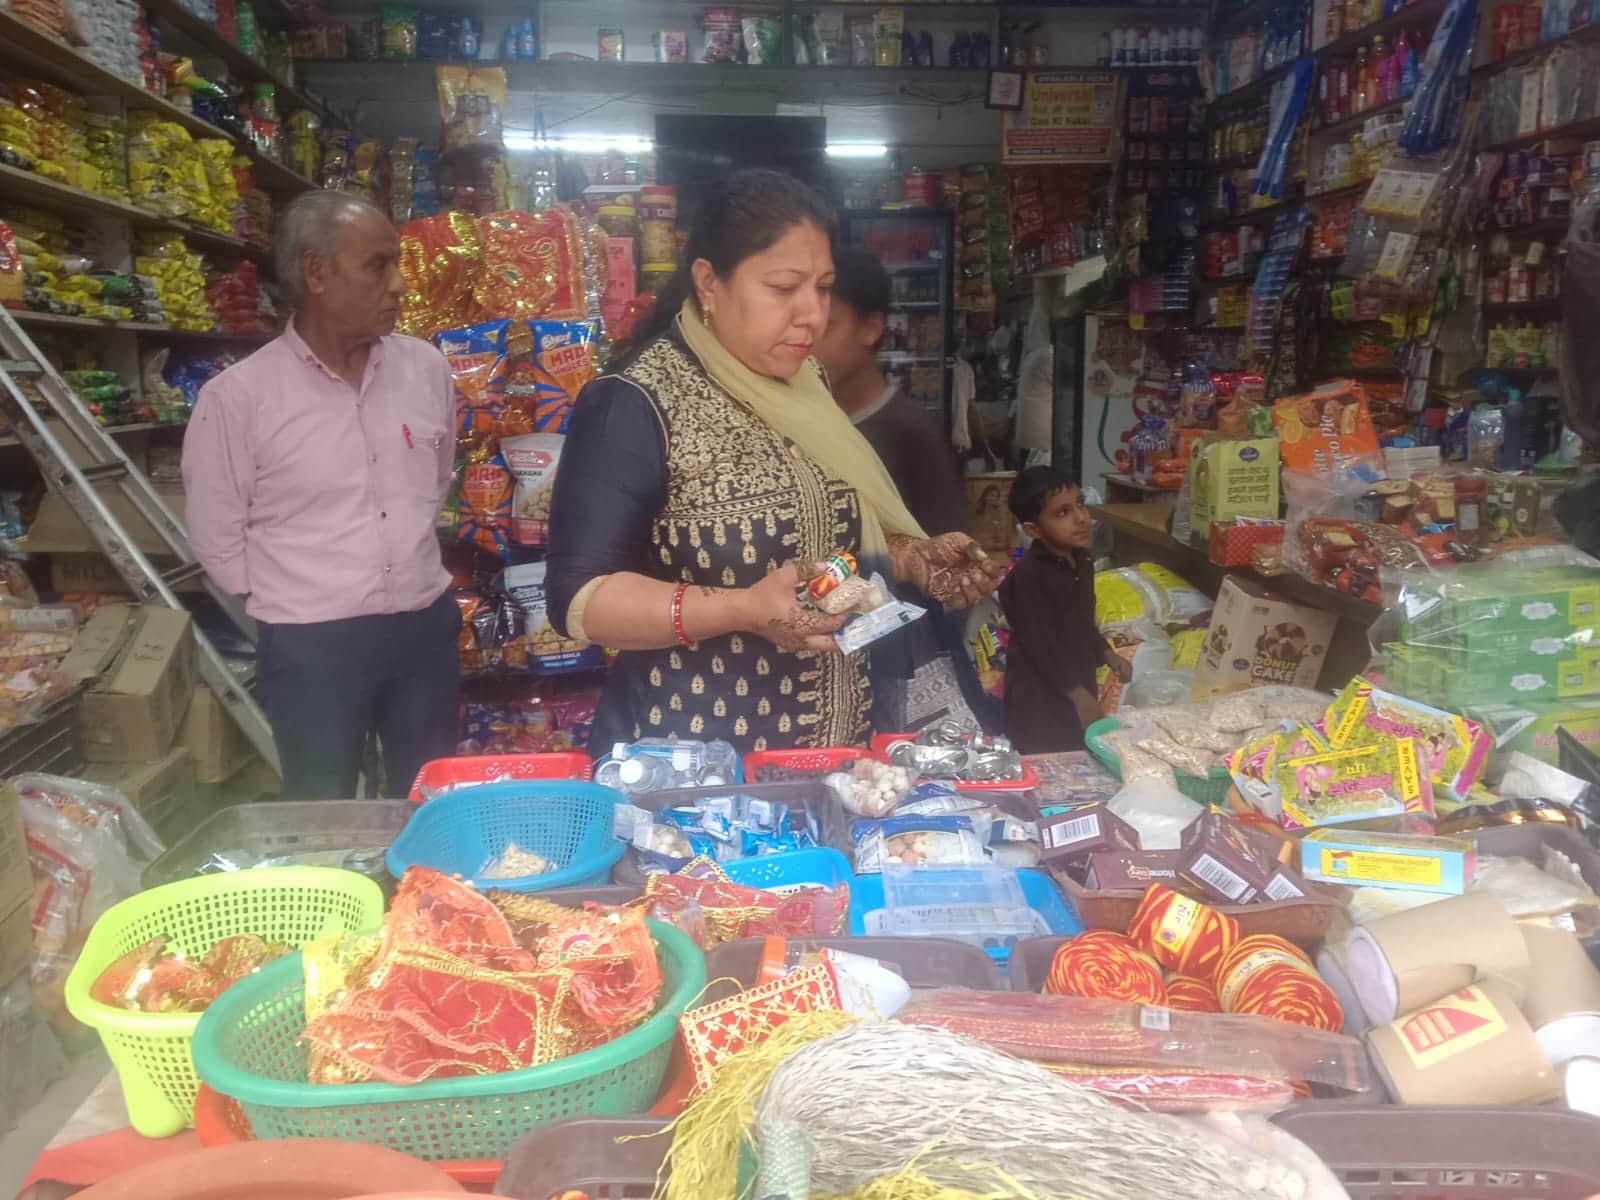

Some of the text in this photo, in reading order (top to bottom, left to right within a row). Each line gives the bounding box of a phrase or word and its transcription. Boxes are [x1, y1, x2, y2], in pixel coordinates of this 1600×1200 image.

[1255, 656, 1297, 671] DONUT
[1251, 665, 1296, 682] CAKE
[1400, 744, 1415, 795] SAVER
